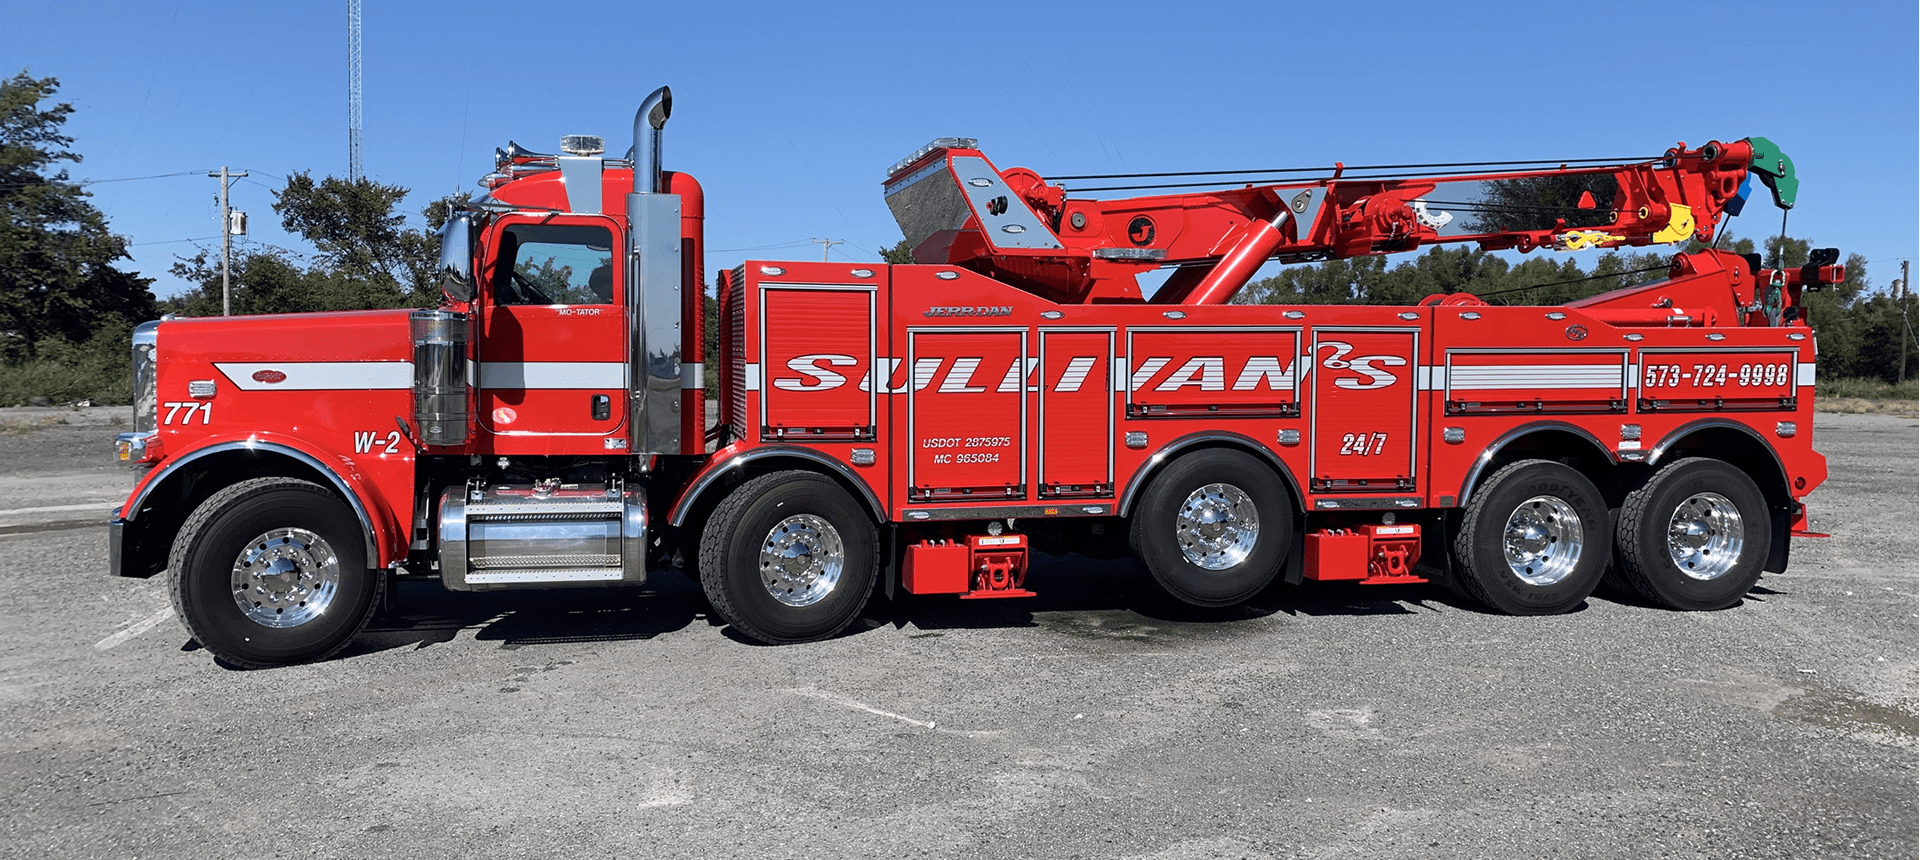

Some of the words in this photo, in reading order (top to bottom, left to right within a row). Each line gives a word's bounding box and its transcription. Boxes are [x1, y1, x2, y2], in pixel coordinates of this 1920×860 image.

[1644, 363, 1789, 388] 573-724-9998
[163, 401, 212, 425] 771
[353, 431, 401, 454] W-2
[922, 437, 962, 448] USDOT
[965, 436, 1011, 448] 2875975
[1339, 432, 1388, 455] 24/7
[933, 454, 952, 464] MC
[956, 453, 999, 464] 965084
